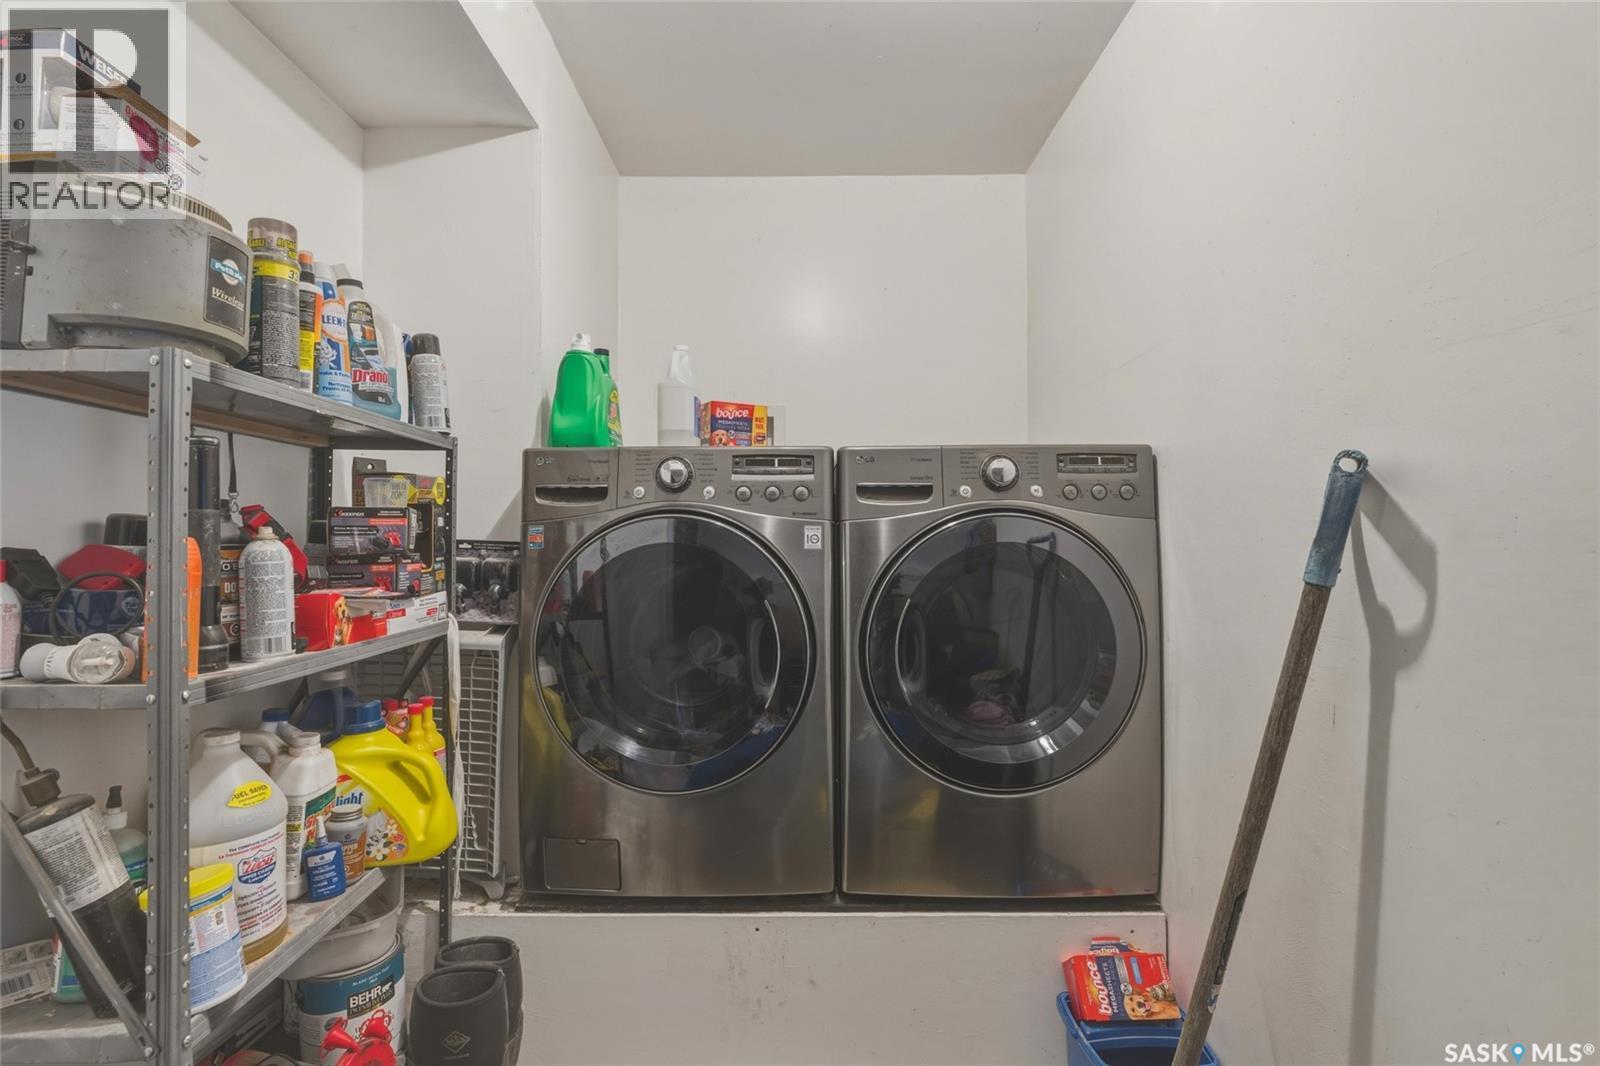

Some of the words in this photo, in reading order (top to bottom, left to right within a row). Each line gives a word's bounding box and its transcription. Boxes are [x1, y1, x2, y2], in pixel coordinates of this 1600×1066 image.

[715, 407, 750, 420] bounce
[349, 985, 382, 1009] BEHR
[1087, 960, 1113, 1016] bounce
